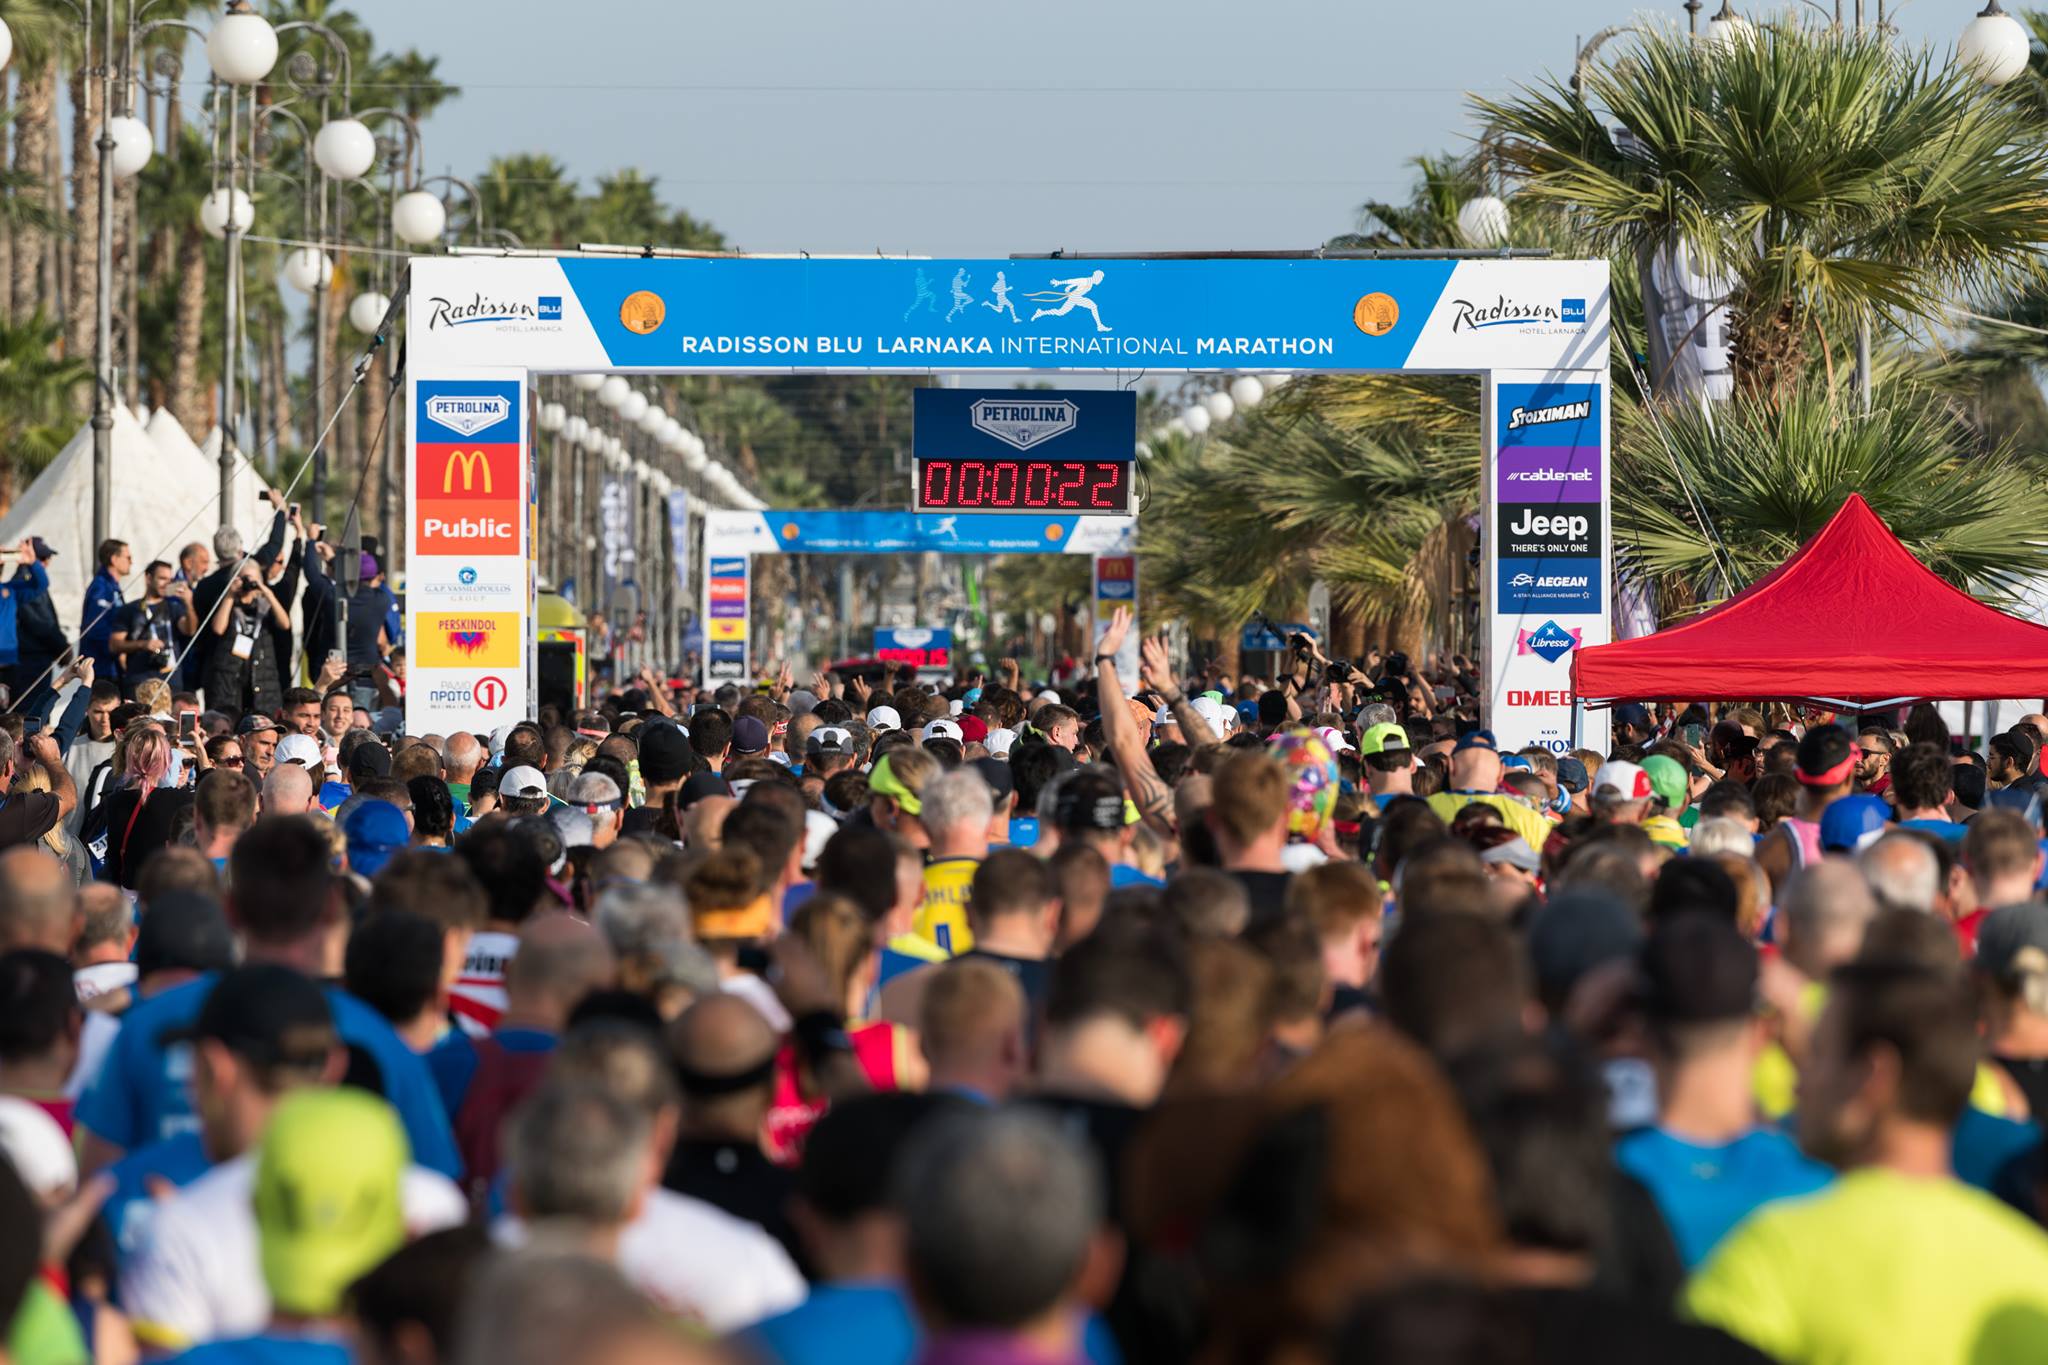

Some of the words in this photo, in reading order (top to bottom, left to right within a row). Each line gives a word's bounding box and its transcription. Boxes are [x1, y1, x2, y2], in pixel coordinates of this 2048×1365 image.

[428, 292, 535, 331] Radisson
[538, 305, 561, 314] BLU
[1452, 294, 1559, 333] Radisson
[1562, 307, 1585, 315] BLU
[682, 336, 808, 353] RADISSON
[816, 336, 862, 353] BLU
[877, 336, 993, 353] LARNAKA
[1001, 337, 1188, 354] INTERNATIONAL
[1197, 337, 1333, 354] MARATHON
[436, 402, 500, 413] PETROLINA
[982, 406, 1066, 421] PETROLINA
[924, 462, 1119, 506] 00:00:22
[424, 518, 511, 537] Public
[1510, 509, 1588, 540] Jeep
[1511, 544, 1546, 552] THERE'S
[1547, 544, 1569, 552] ONLY
[1570, 544, 1588, 552] ONE
[1536, 577, 1588, 587] AEGEAN
[439, 619, 497, 630] PERSKINDOL
[1531, 637, 1570, 647] Libresse
[1507, 690, 1573, 706] OMEG
